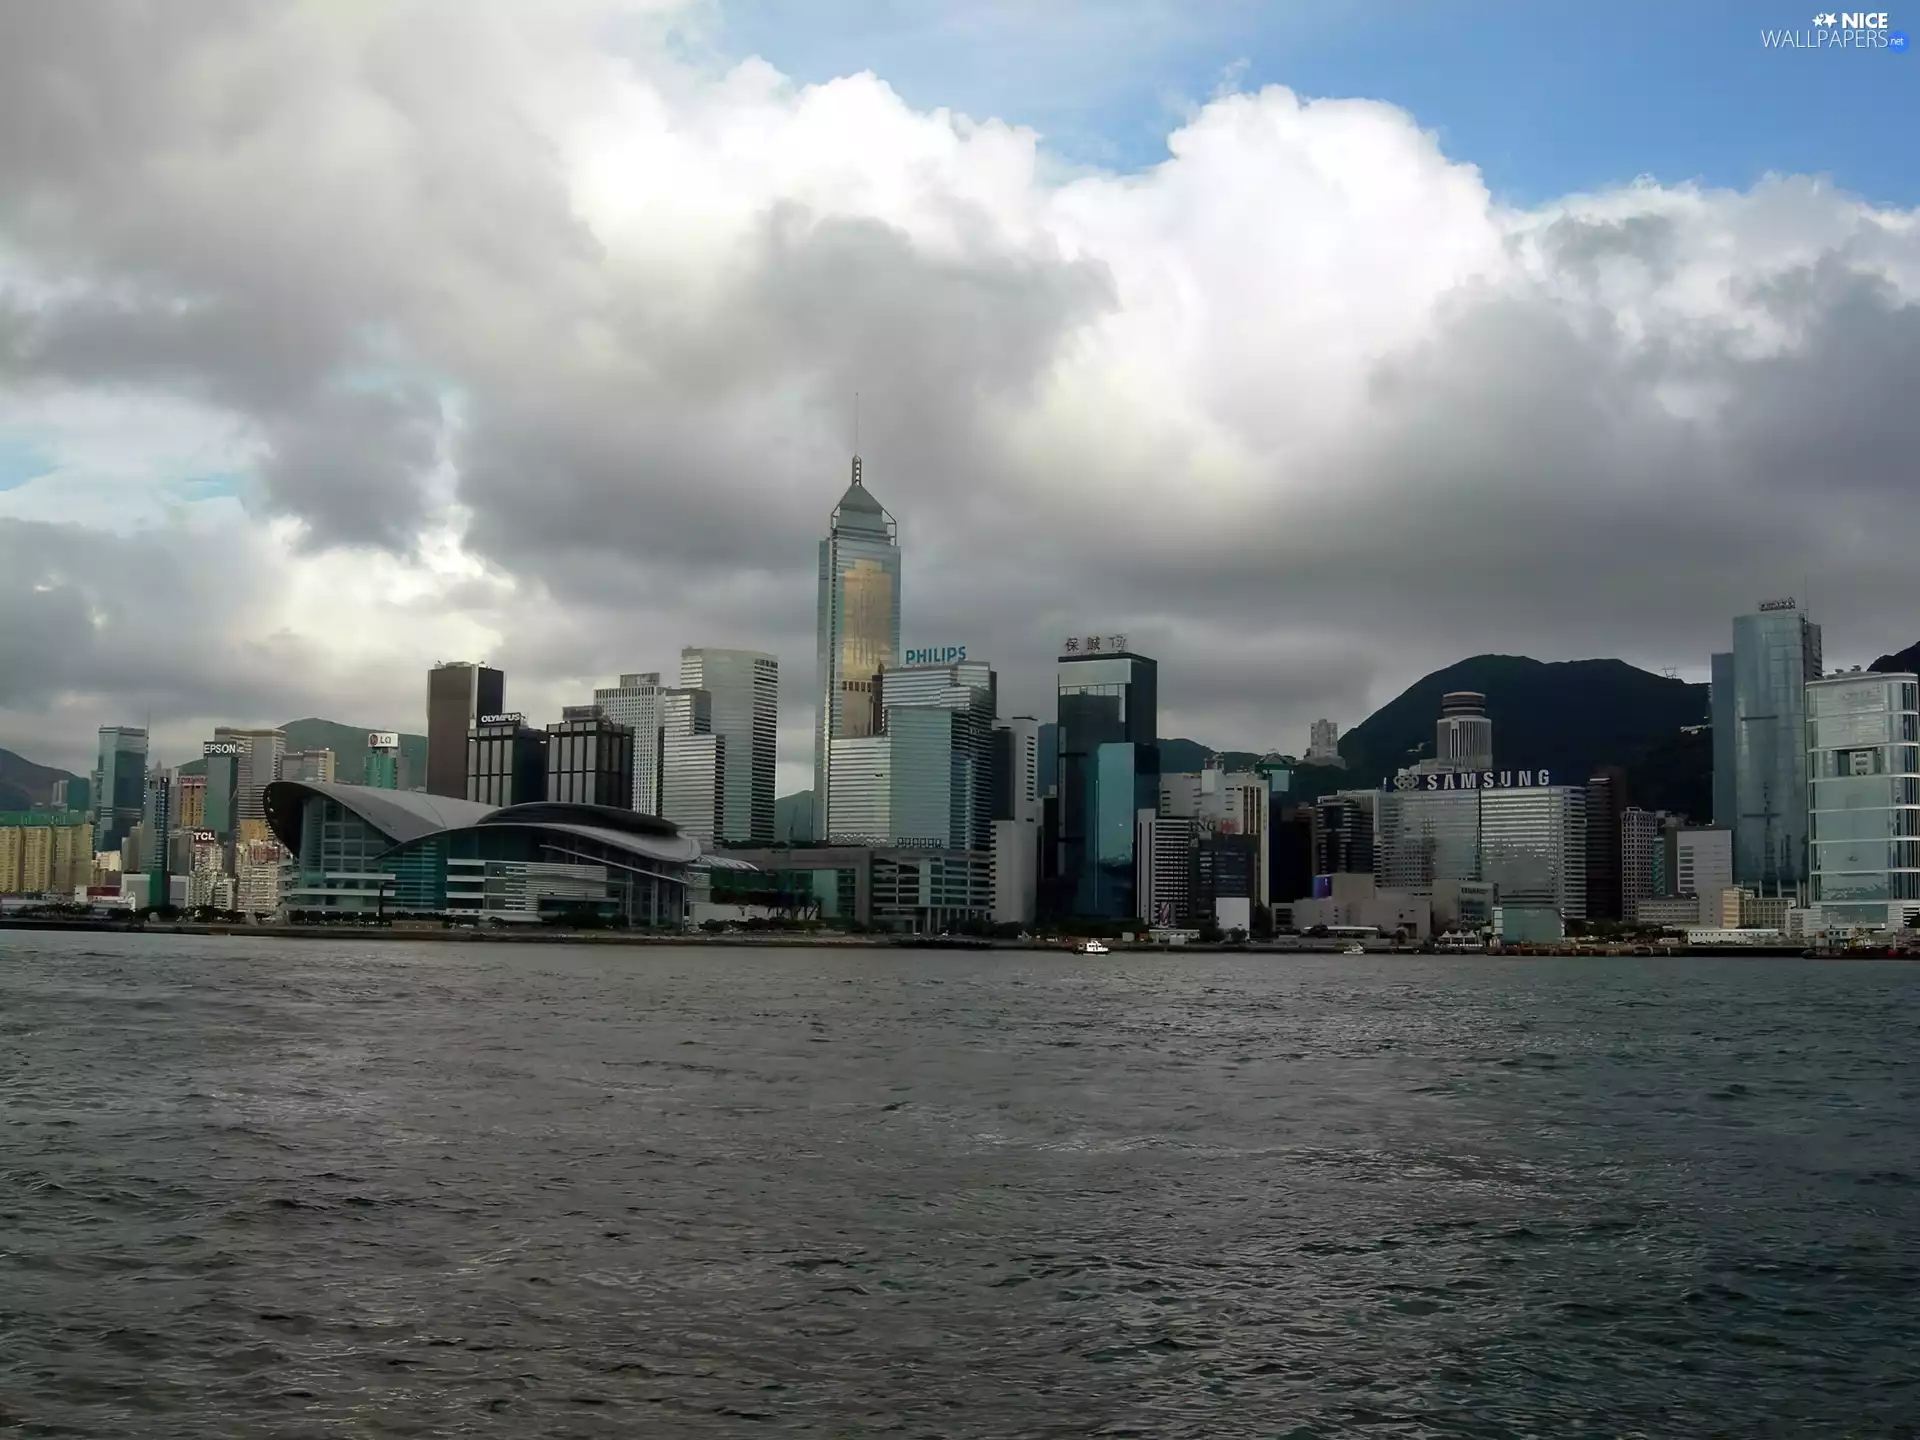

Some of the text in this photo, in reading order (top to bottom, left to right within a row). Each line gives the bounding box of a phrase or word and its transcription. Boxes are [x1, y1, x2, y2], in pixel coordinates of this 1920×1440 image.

[905, 645, 967, 665] PHILIPS
[481, 712, 521, 723] OLYMPUS
[203, 743, 236, 754] EPSON
[1426, 769, 1550, 791] SAMSUNG
[194, 831, 215, 842] TCL
